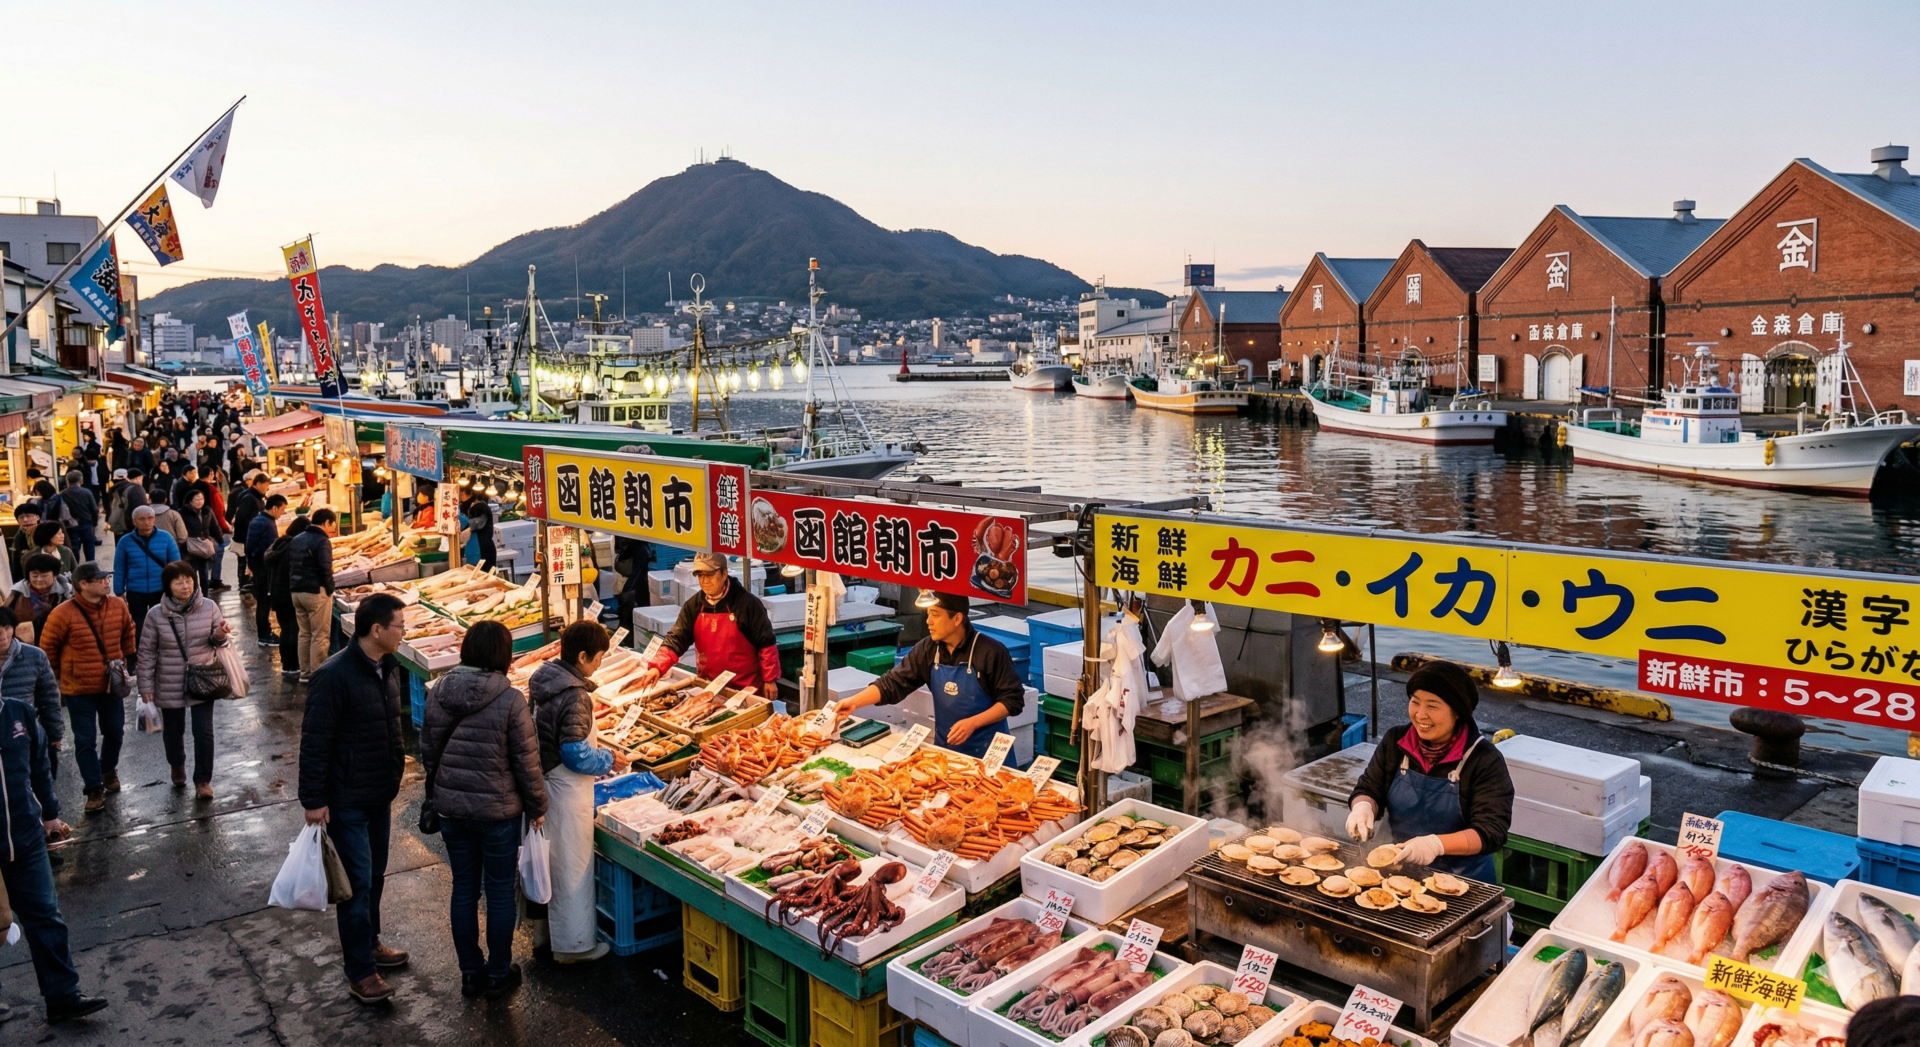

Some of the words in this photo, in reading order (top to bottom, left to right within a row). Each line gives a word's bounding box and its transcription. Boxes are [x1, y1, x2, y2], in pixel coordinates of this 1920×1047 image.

[1751, 309, 1841, 336] 金森倉庫
[556, 464, 694, 535] 函館朝市
[716, 474, 741, 548] 鮮鮮
[793, 508, 959, 581] 函館朝市
[1111, 522, 1187, 558] 新鮮
[1111, 555, 1188, 591] 海鮮
[1800, 587, 1910, 636] 漢字
[1710, 960, 1799, 1009] 新鮮海鮮
